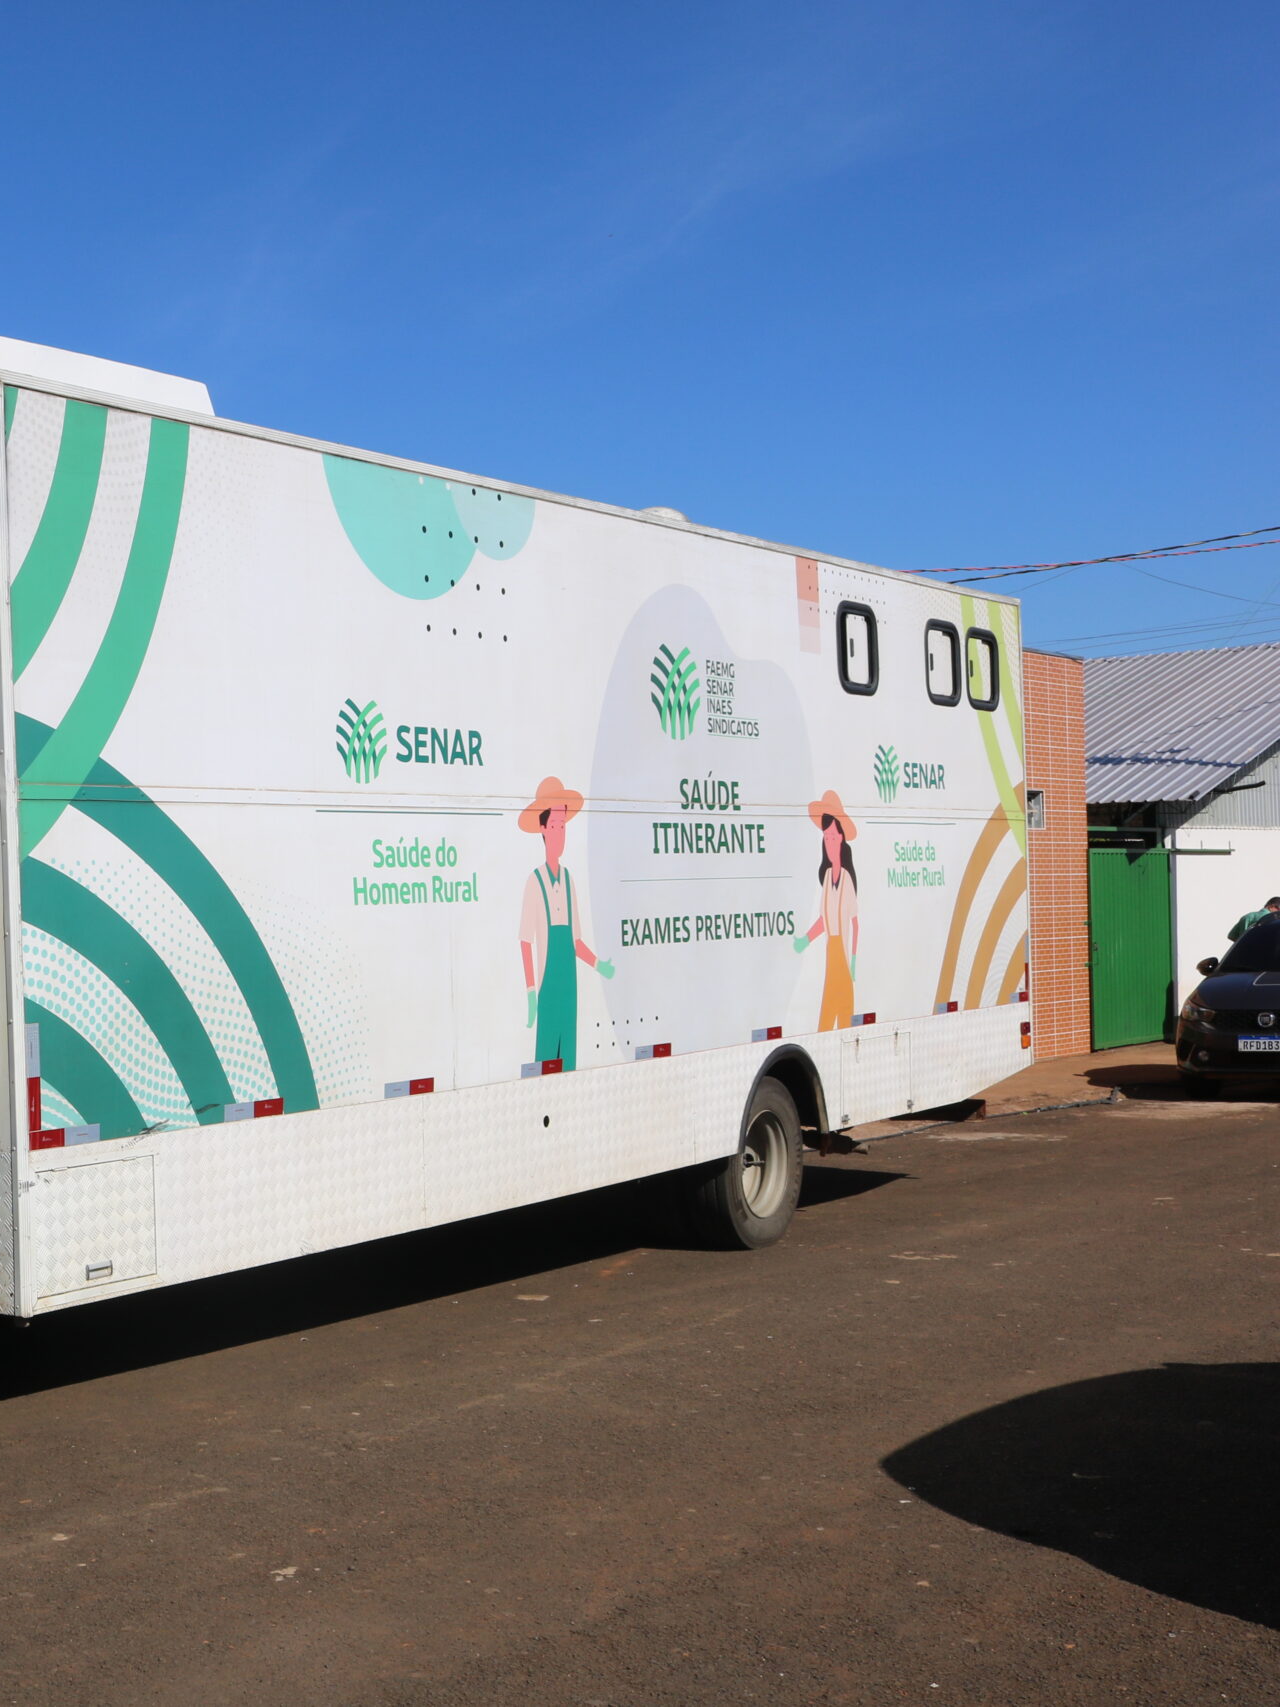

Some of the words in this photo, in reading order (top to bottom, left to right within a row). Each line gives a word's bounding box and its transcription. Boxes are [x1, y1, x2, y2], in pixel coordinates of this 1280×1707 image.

[705, 659, 735, 678] FAEMG
[706, 679, 735, 697] SENAR
[706, 698, 733, 715] INAES
[707, 717, 760, 737] SINDICATOS
[395, 724, 484, 767] SENAR
[903, 761, 945, 790] SENAR
[679, 770, 741, 811] SAÚDE
[372, 836, 431, 868] Saúde
[435, 836, 458, 867] do
[652, 822, 766, 854] ITINERANTE
[894, 840, 923, 862] Saúde
[925, 840, 936, 861] da
[353, 876, 428, 906] Homem
[431, 872, 479, 903] Rural
[887, 865, 920, 888] Mulher
[922, 865, 945, 887] Rural
[620, 915, 691, 947] EXAMES
[695, 910, 795, 942] PREVENTIVOS
